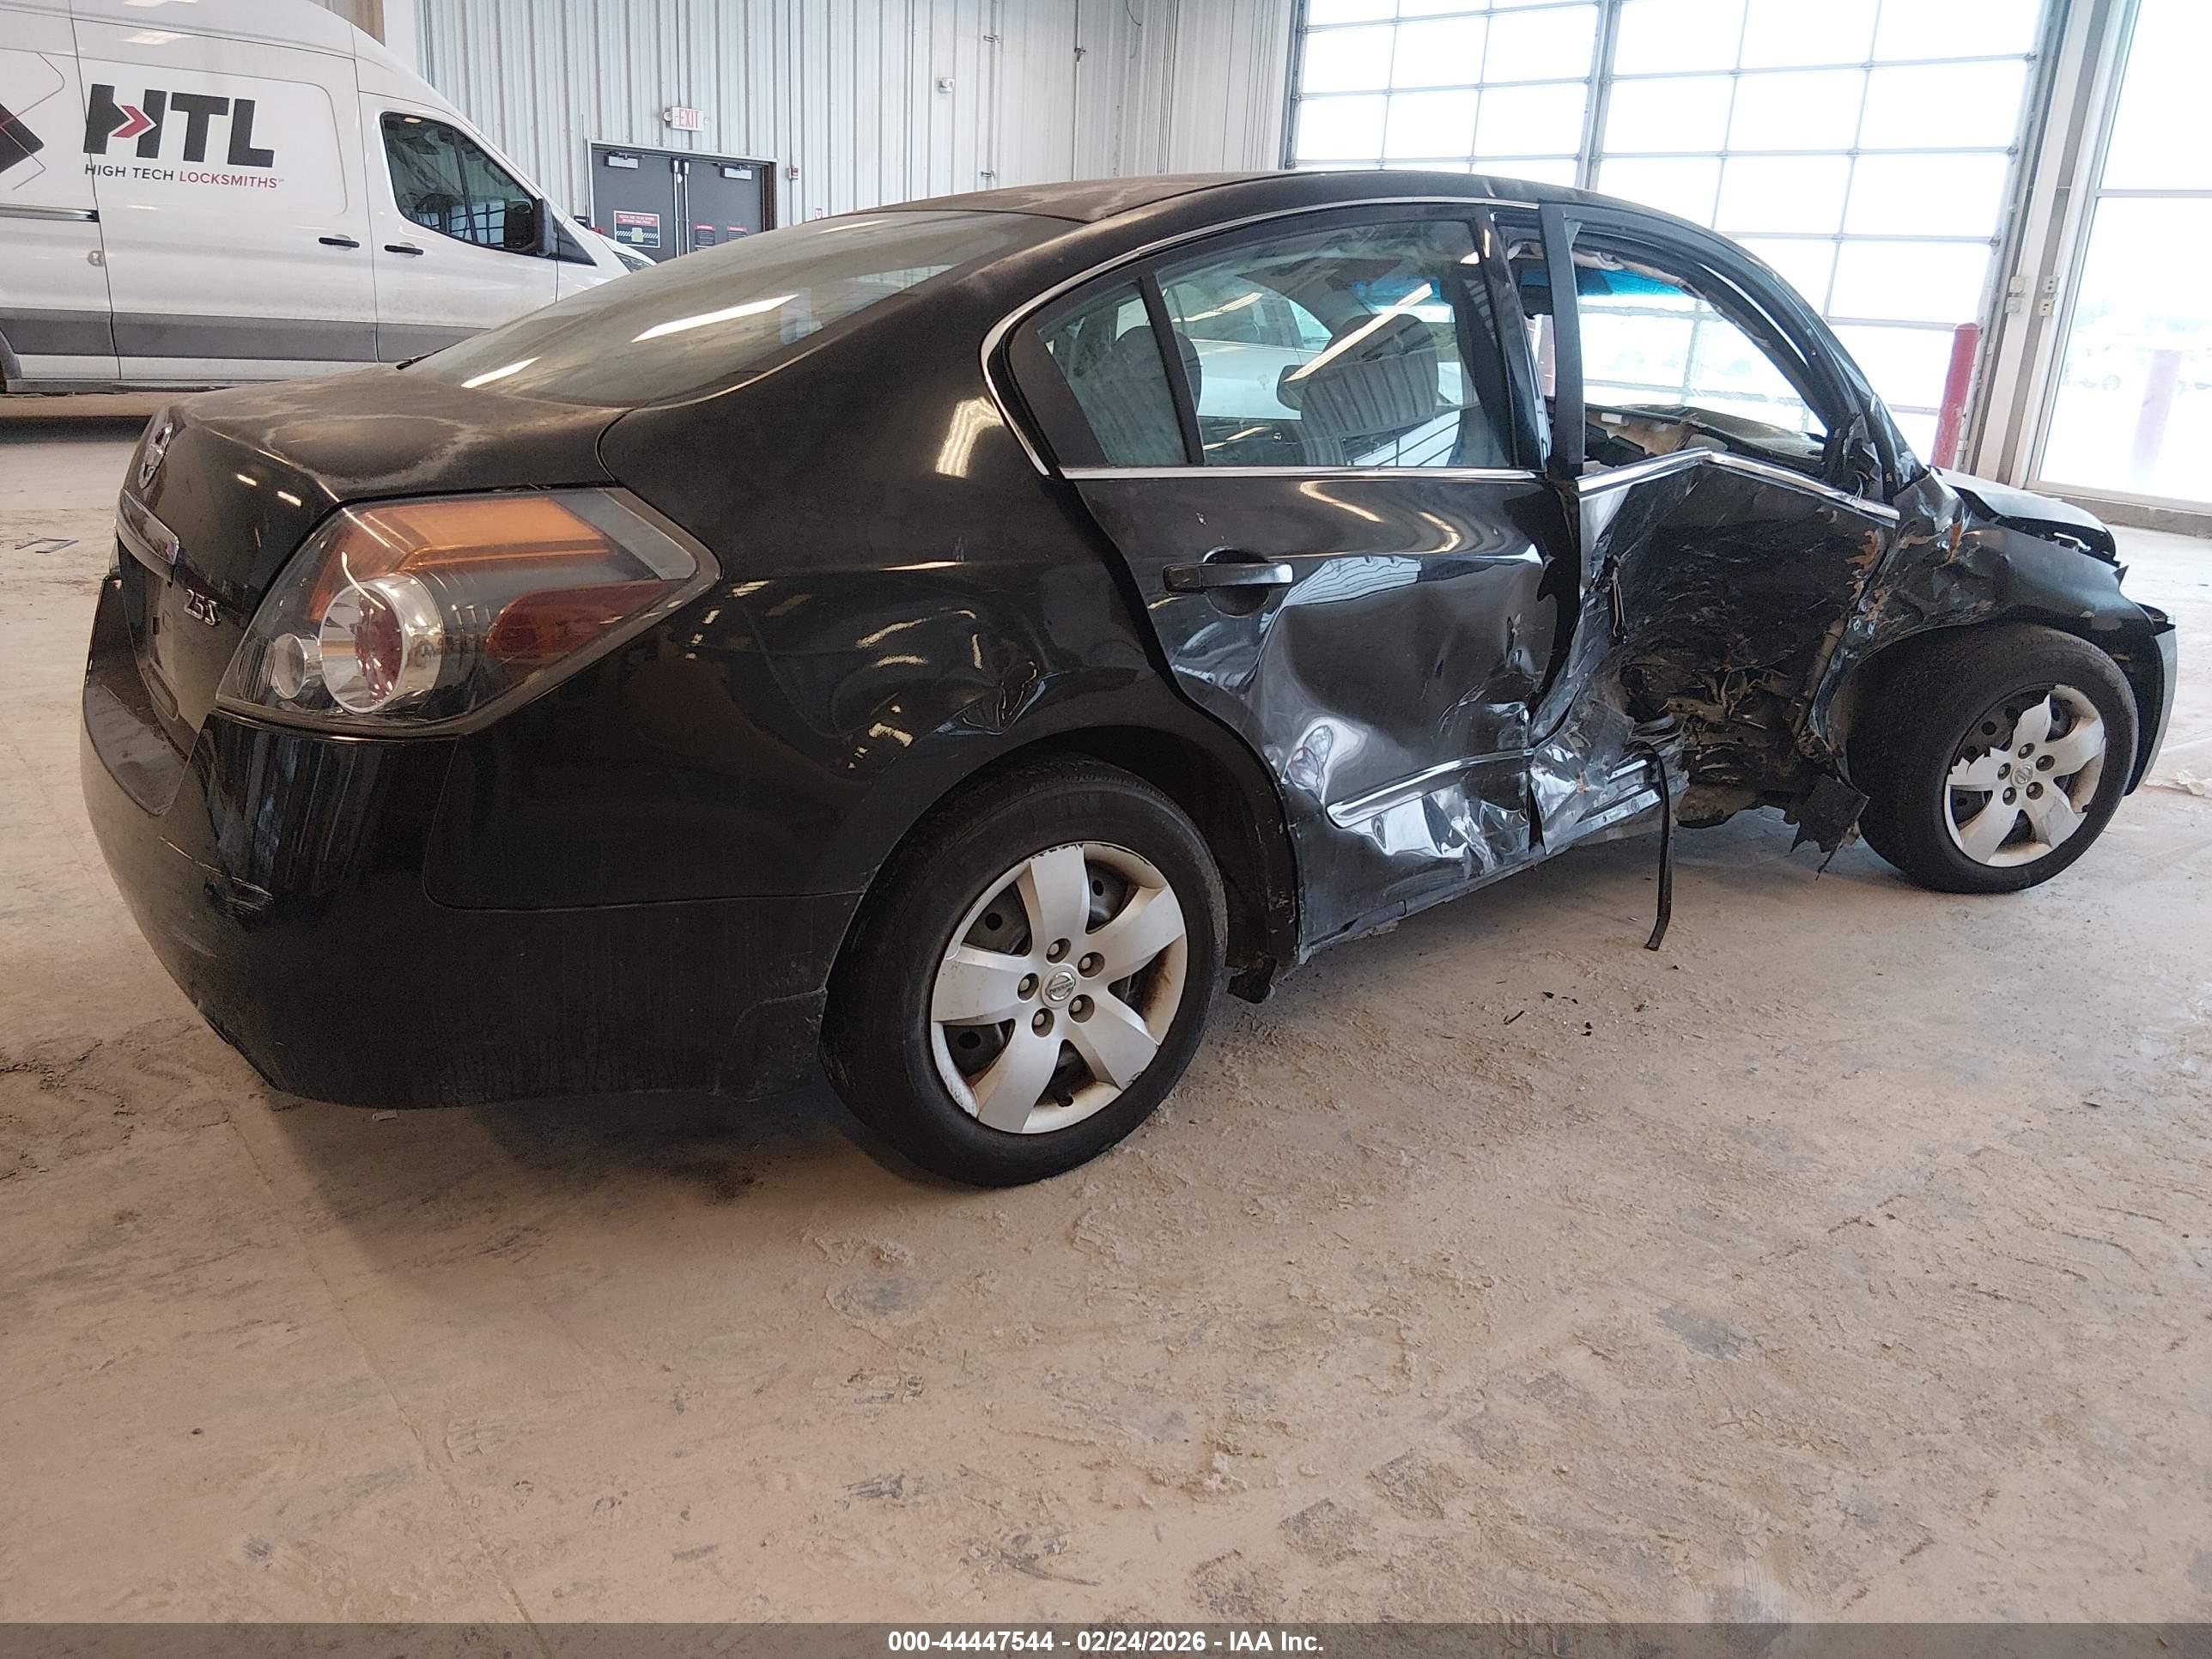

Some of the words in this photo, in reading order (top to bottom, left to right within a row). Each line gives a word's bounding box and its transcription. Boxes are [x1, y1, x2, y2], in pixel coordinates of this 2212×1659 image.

[83, 83, 275, 167] HTL
[678, 109, 700, 129] EXIT
[84, 164, 126, 178] HIGH
[132, 167, 175, 181] TECH
[179, 170, 277, 189] LOCKSMITHS
